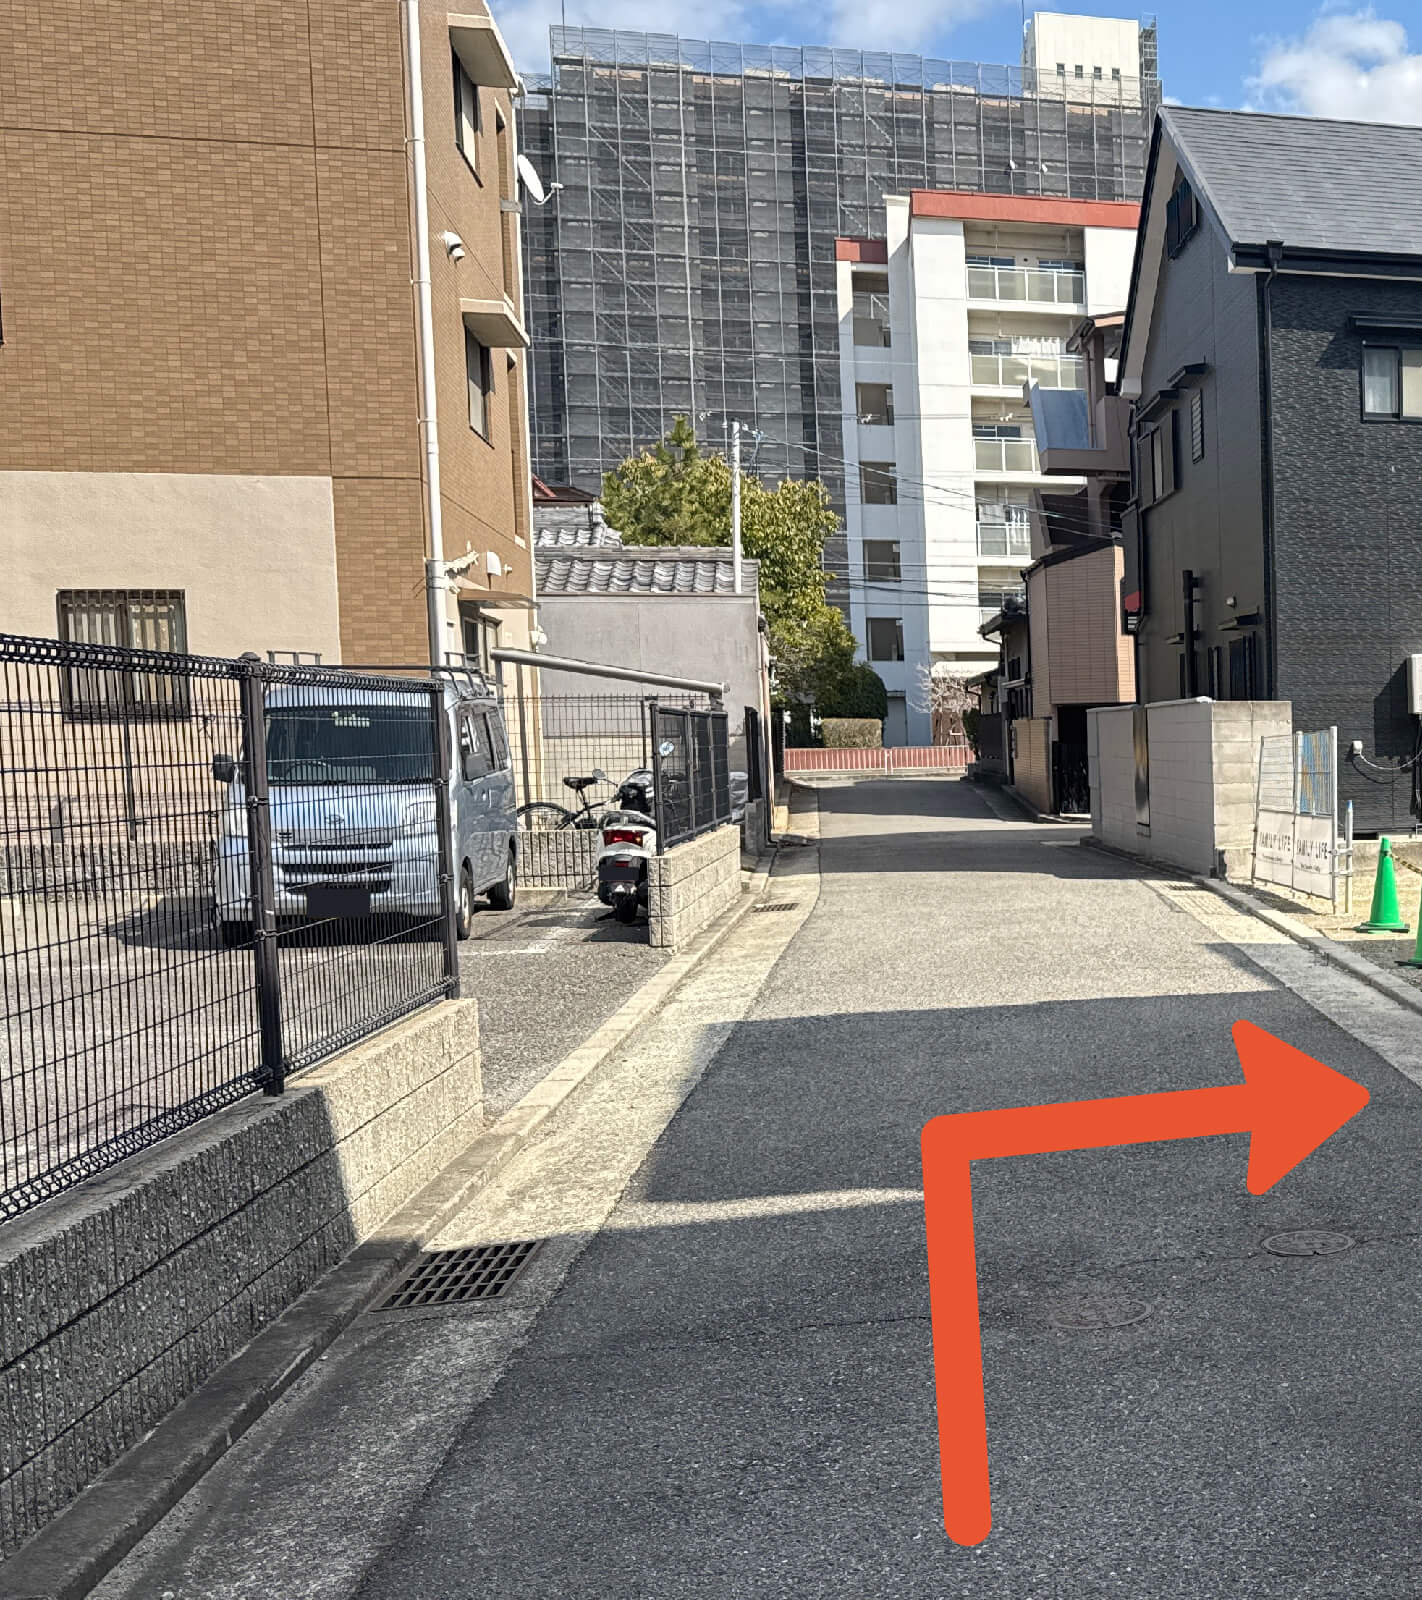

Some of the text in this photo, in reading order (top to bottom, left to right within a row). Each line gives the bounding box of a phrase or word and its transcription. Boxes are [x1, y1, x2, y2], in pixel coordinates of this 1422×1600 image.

[1259, 832, 1291, 852] FAMILY LIFE
[1297, 839, 1328, 859] FAMILY LIFE
